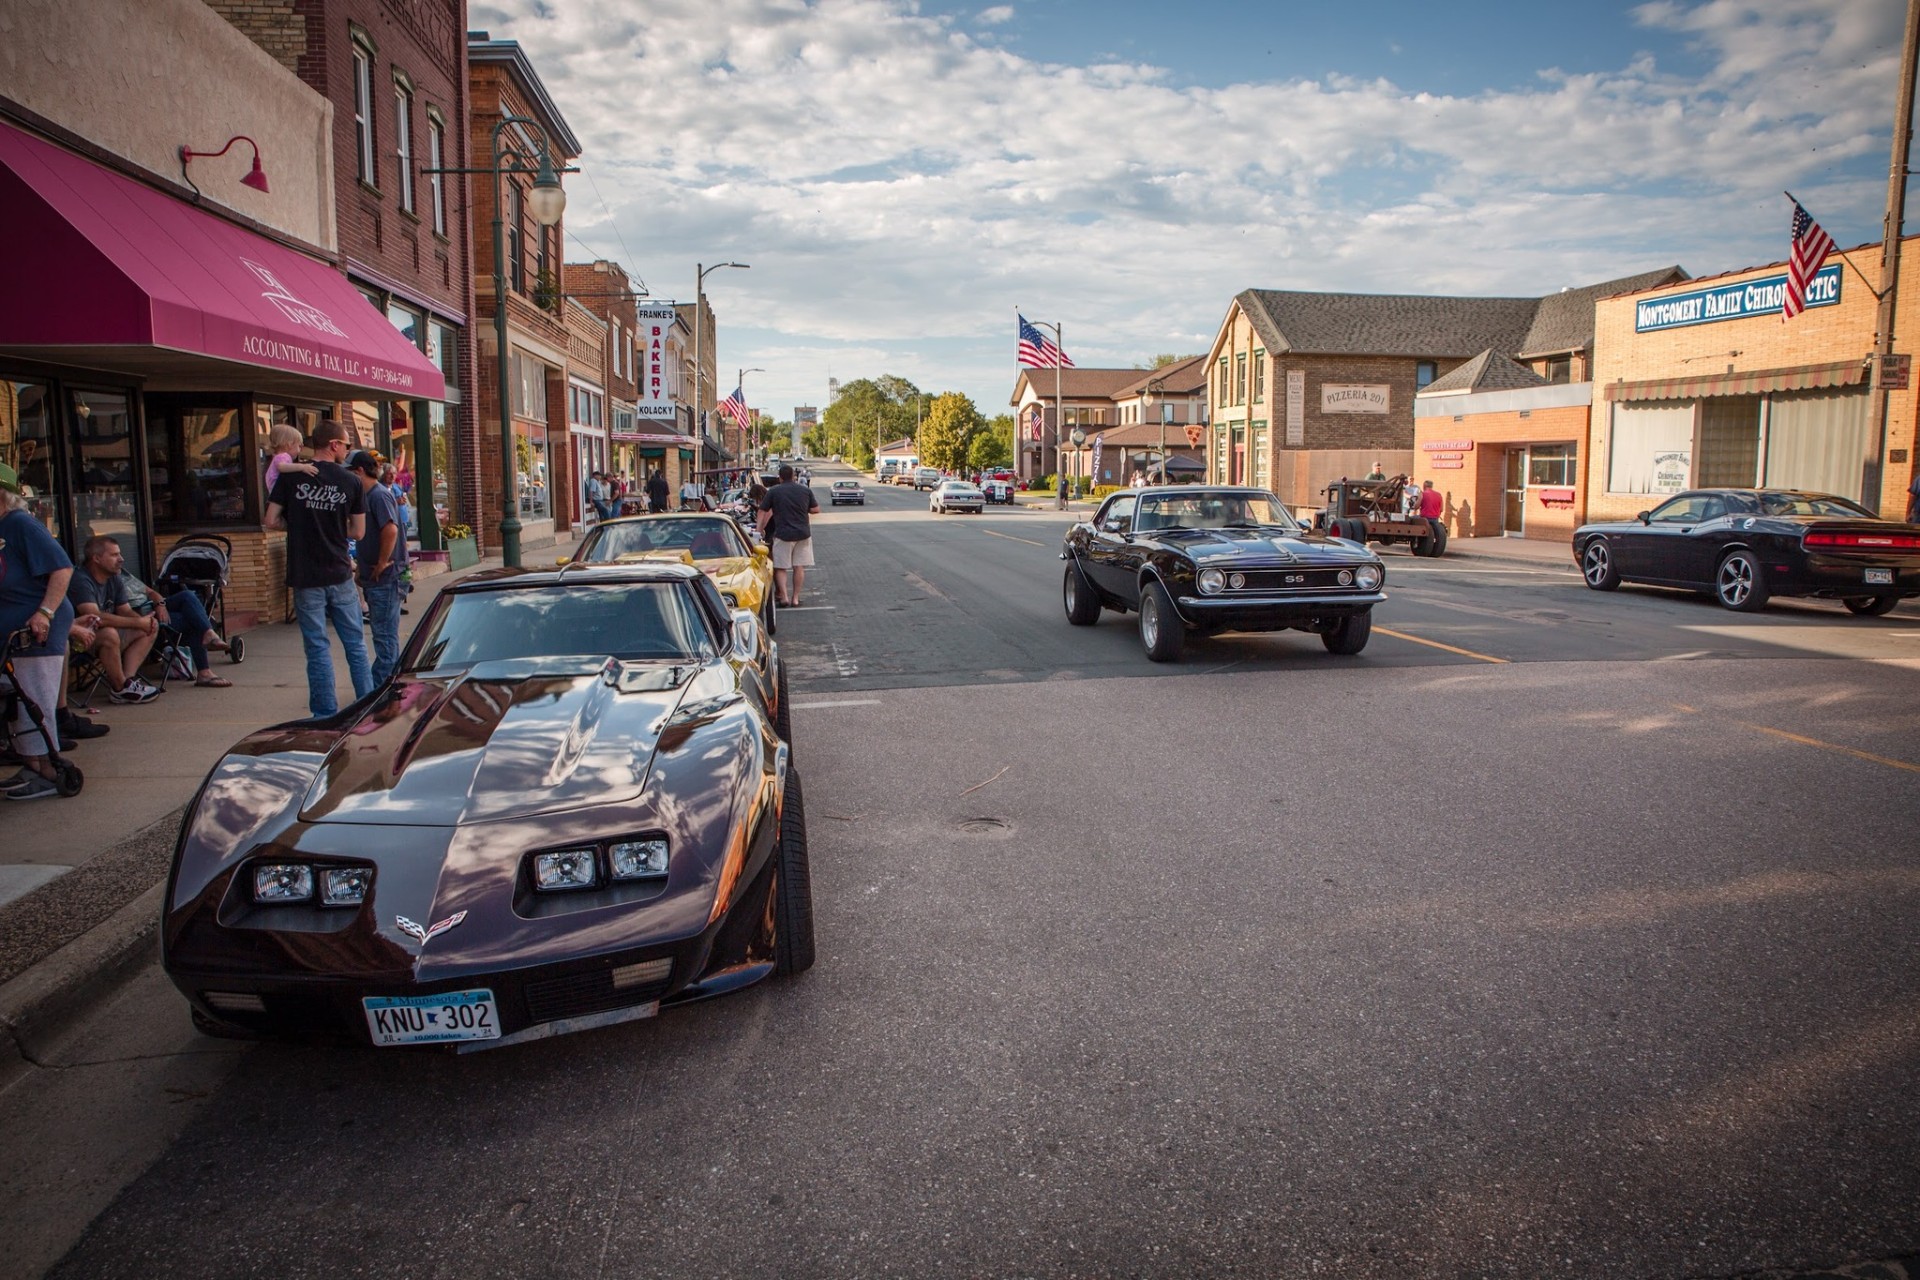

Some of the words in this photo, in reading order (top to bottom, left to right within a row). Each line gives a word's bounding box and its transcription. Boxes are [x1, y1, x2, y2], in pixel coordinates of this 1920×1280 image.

[1637, 297, 1703, 327] MONTGOMERY
[1705, 291, 1743, 317] FAMILY
[1744, 275, 1837, 310] CHIROCTIC
[639, 310, 674, 319] FRANKE'S
[243, 335, 312, 366] ACCOUNTING
[314, 352, 321, 367] &
[344, 359, 360, 376] LLC
[371, 366, 413, 388] 507-364-5400
[651, 326, 661, 399] BAKERY
[1327, 390, 1367, 404] PIZZERIA
[1370, 393, 1385, 405] 201
[639, 406, 673, 415] KOLACKY
[295, 483, 347, 504] Silver
[1285, 575, 1304, 583] SS
[374, 1007, 425, 1034] KNU
[442, 1004, 491, 1030] 302
